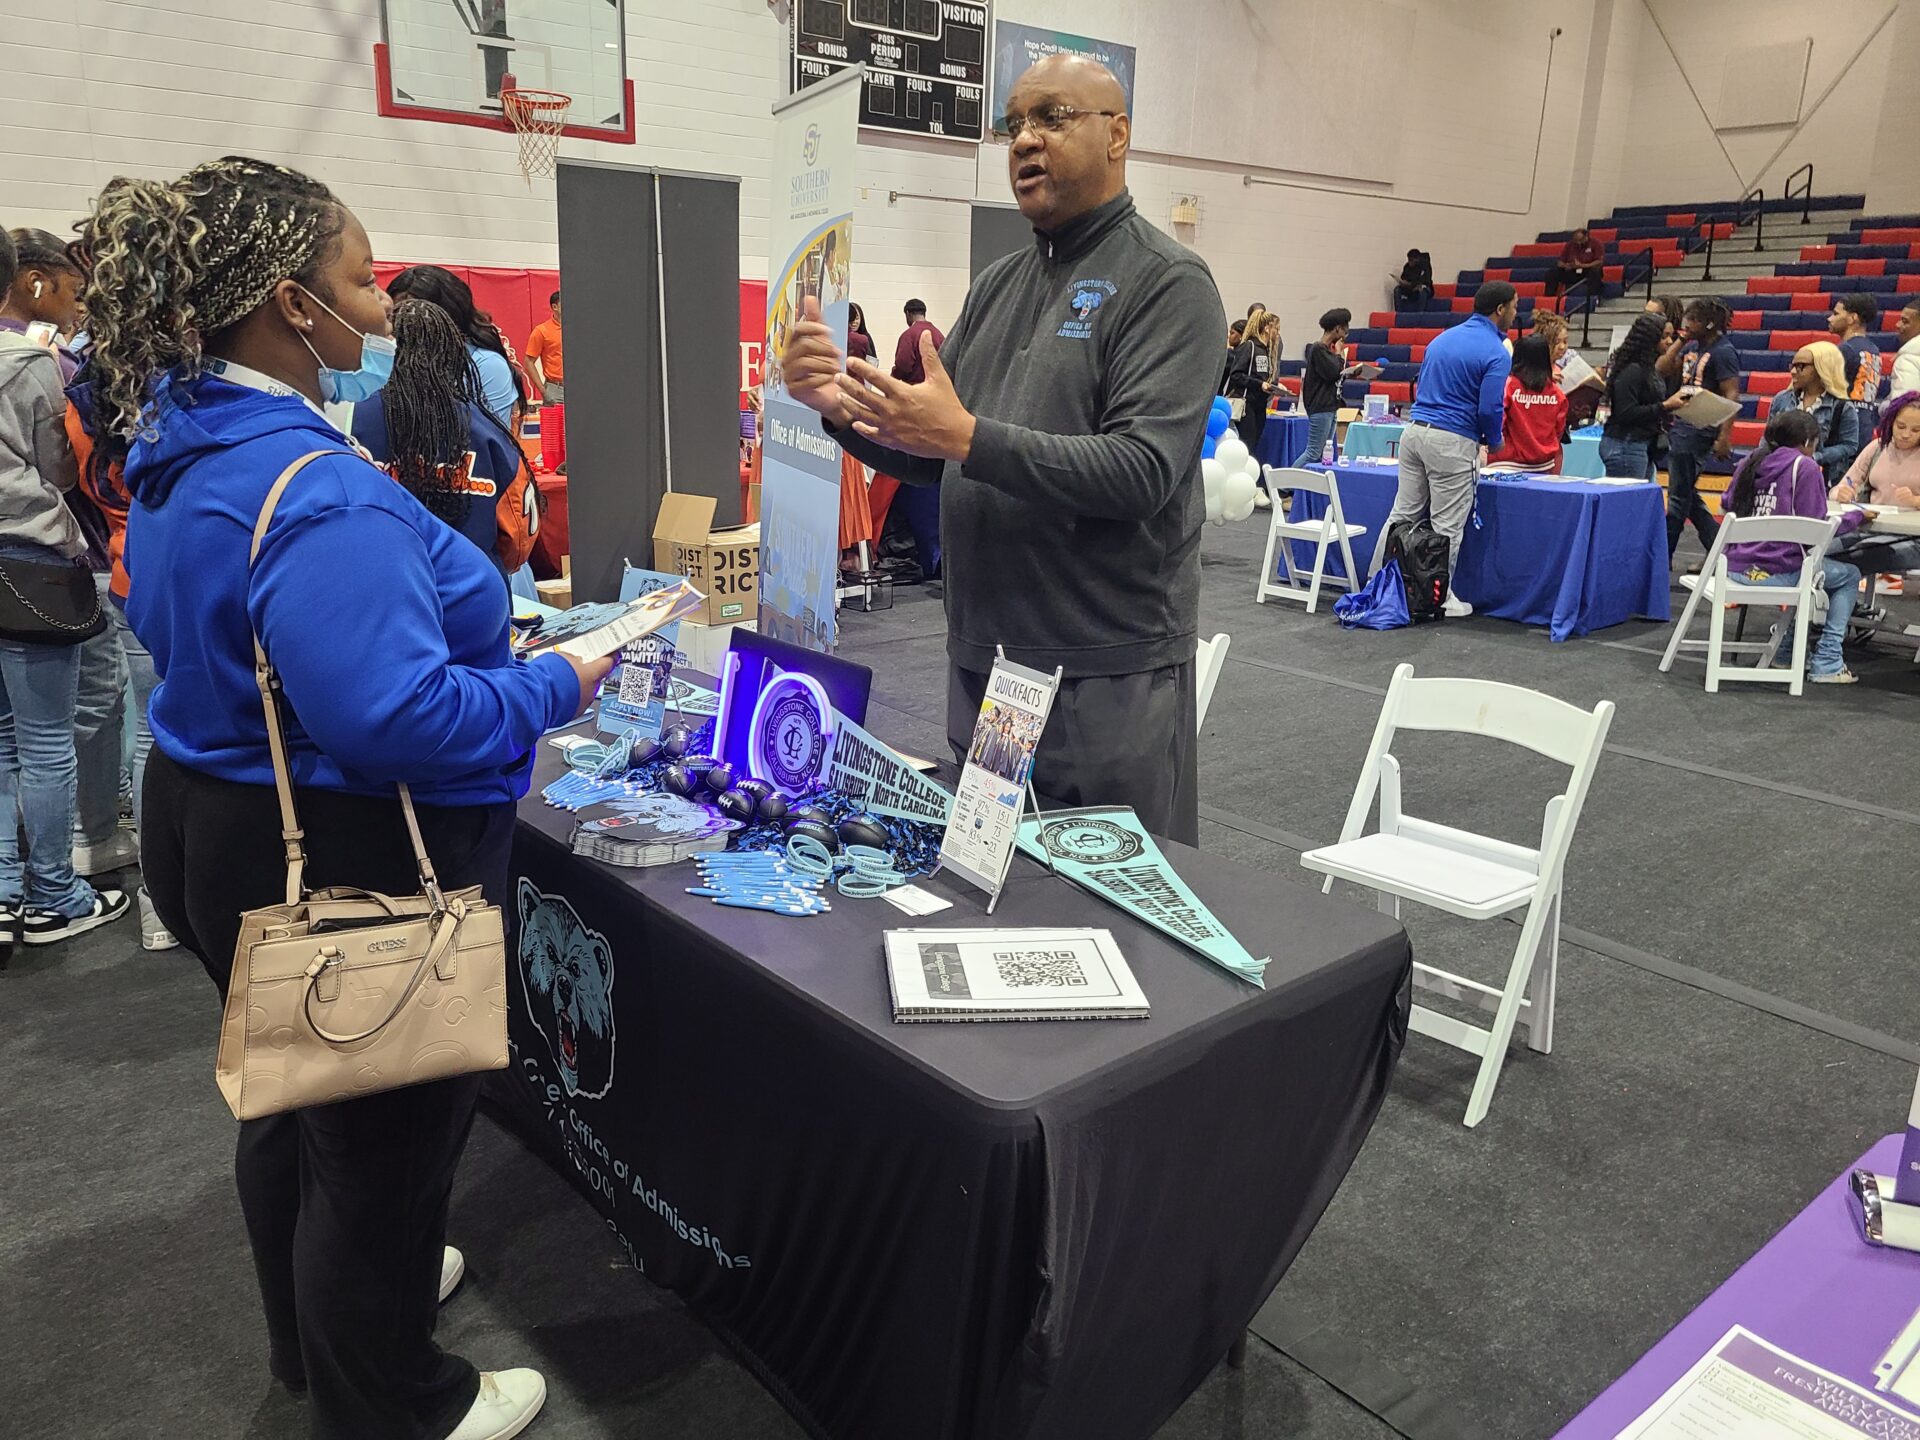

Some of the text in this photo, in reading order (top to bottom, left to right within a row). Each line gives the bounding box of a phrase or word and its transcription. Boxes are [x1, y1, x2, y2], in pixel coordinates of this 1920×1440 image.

[942, 4, 985, 26] VISITOR
[878, 33, 895, 45] POSS
[818, 42, 848, 59] BONUS
[871, 43, 902, 59] PERIOD
[1024, 39, 1040, 50] Hope
[1041, 42, 1058, 53] Credit
[1058, 46, 1074, 56] Union
[1080, 51, 1096, 60] proud
[1102, 54, 1109, 62] be
[1028, 51, 1038, 60] the
[801, 60, 830, 77] FOULS
[863, 71, 895, 87] PLAYER
[940, 63, 966, 78] BONUS
[907, 77, 932, 93] FOULS
[955, 85, 980, 100] FOULS
[929, 121, 944, 135] TOL
[791, 168, 831, 194] SOUTHERN
[790, 188, 829, 209] UNIVERSITY
[1512, 388, 1558, 409] Auyanna
[771, 418, 836, 462] Office of Admissions
[678, 548, 702, 562] DIST
[713, 547, 760, 571] DIST
[626, 639, 657, 652] WHO
[621, 651, 661, 664] YA WIT!!
[994, 675, 1043, 708] QUICKFACTS
[609, 700, 654, 718] APPLY NOW!
[769, 702, 820, 755] LIVINGSTONE COLLEGE
[769, 750, 801, 784] SALISBURY,
[832, 721, 948, 810] LIVINGSTONE COLLEGE
[872, 782, 902, 811] NORTH
[900, 794, 947, 821] CAROLINA
[1071, 820, 1132, 843] LIVINGSTONE
[1171, 908, 1214, 939] COLLEGE
[155, 933, 166, 943] 23
[367, 937, 407, 952] GUESS
[934, 951, 951, 992] Livingstone College
[569, 1108, 611, 1166] Office
[613, 1159, 629, 1185] of
[631, 1175, 751, 1269] Admissions
[1774, 1366, 1873, 1421] FRESHMAN
[1816, 1376, 1872, 1410] WILEY
